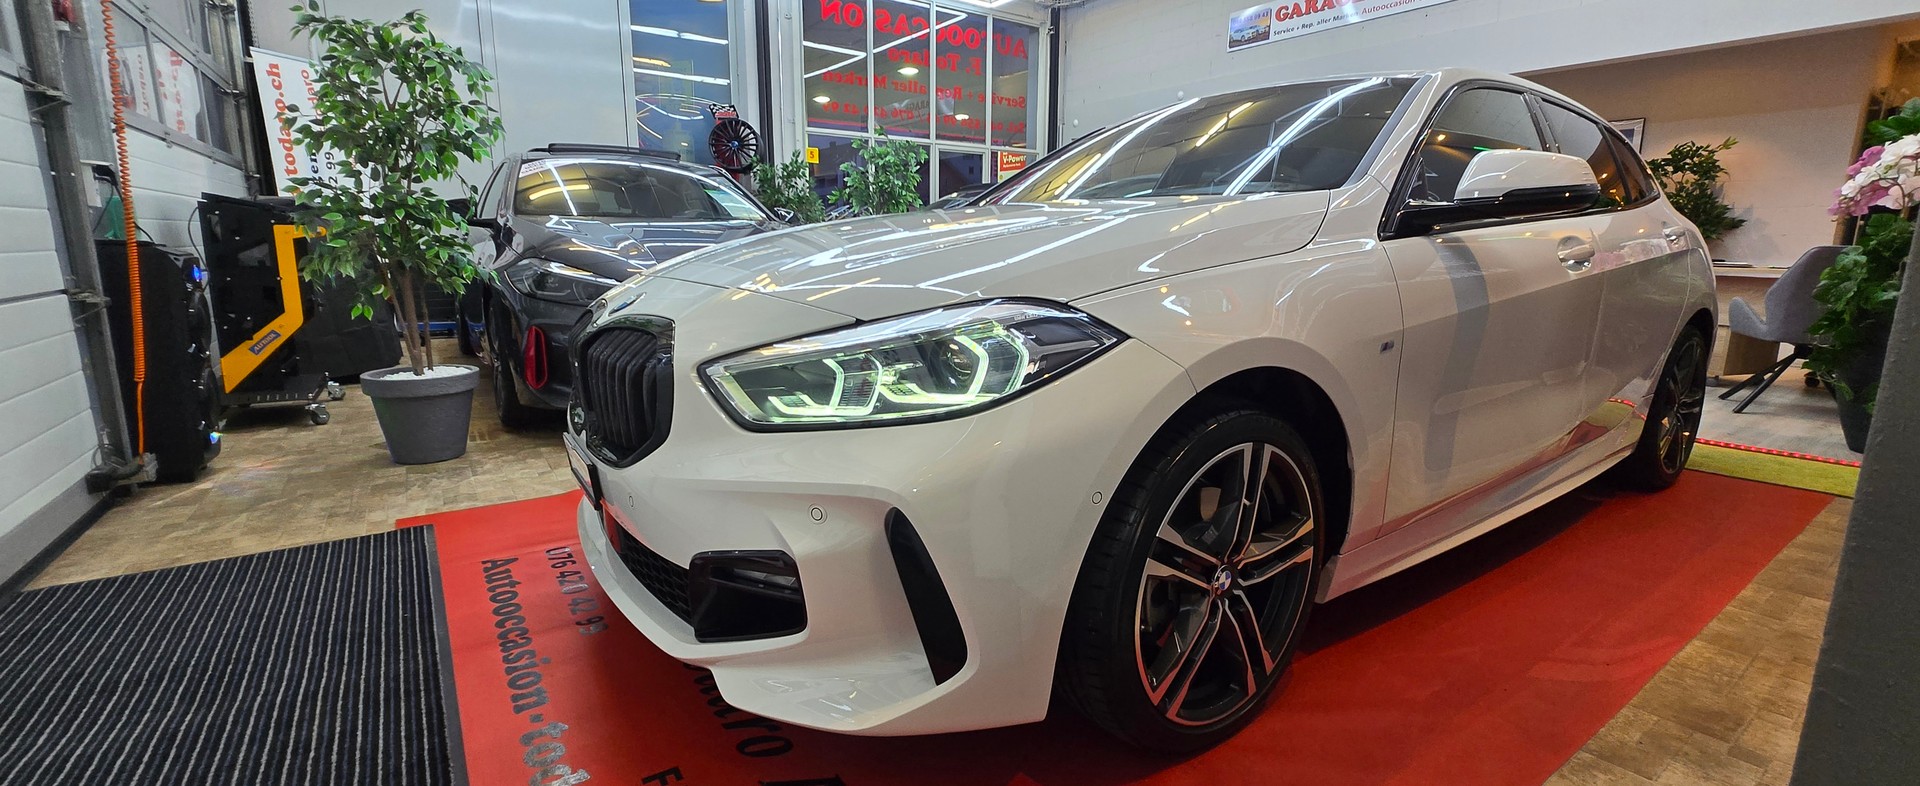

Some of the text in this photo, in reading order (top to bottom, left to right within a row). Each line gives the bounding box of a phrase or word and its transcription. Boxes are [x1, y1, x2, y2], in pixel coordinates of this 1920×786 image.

[1273, 27, 1294, 36] Service
[1316, 17, 1331, 26] aller
[324, 152, 336, 170] 99
[808, 151, 816, 160] 5
[544, 547, 576, 569] 076
[556, 570, 588, 595] 420
[567, 597, 598, 616] 42
